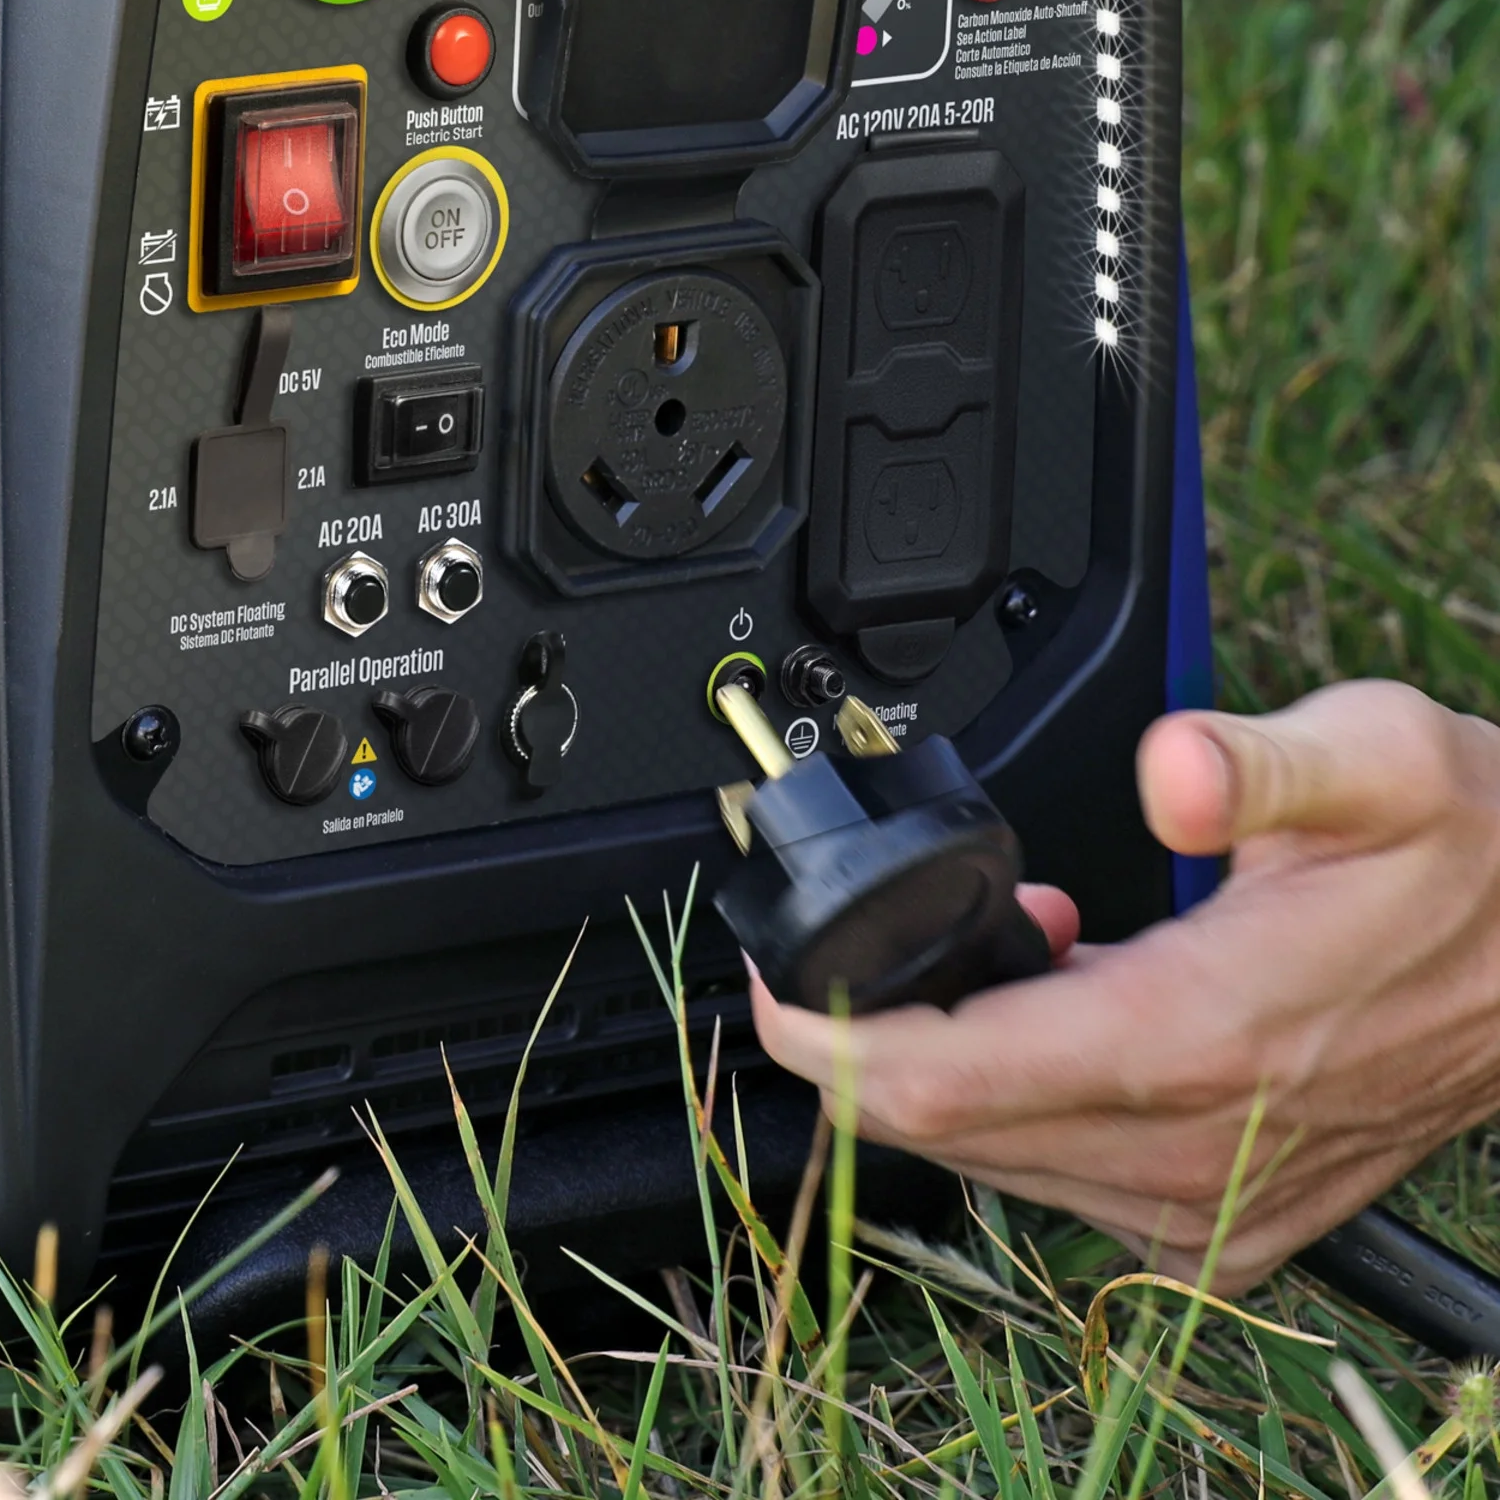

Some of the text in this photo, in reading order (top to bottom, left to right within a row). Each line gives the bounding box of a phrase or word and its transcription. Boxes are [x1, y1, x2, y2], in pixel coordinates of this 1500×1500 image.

[958, 1, 1088, 29] Carbon Monoxide Auto-Shutoff
[956, 25, 1027, 47] See Action Label
[955, 42, 1031, 64] Corte Automático
[955, 52, 1082, 80] Consulte la Etiqueta de Acción
[406, 104, 484, 131] Push Button
[836, 97, 995, 140] AC 120V 20A 5-20R
[406, 125, 484, 146] Electric Start
[431, 207, 461, 229] ON
[425, 228, 466, 251] OFF
[383, 320, 450, 349] Eco Mode
[365, 343, 466, 370] Combustible Eficiente
[279, 368, 322, 395] DC 5V
[298, 465, 327, 489] 2.1A
[149, 486, 178, 511] 2.1A
[418, 499, 482, 534] AC 30A
[318, 513, 383, 549] AC 20A
[170, 601, 286, 635] DC System Floating
[180, 623, 275, 651] Sistema DC Flotante
[289, 647, 445, 695] Parallel Operation
[322, 808, 405, 835] Salida en Paralelo
